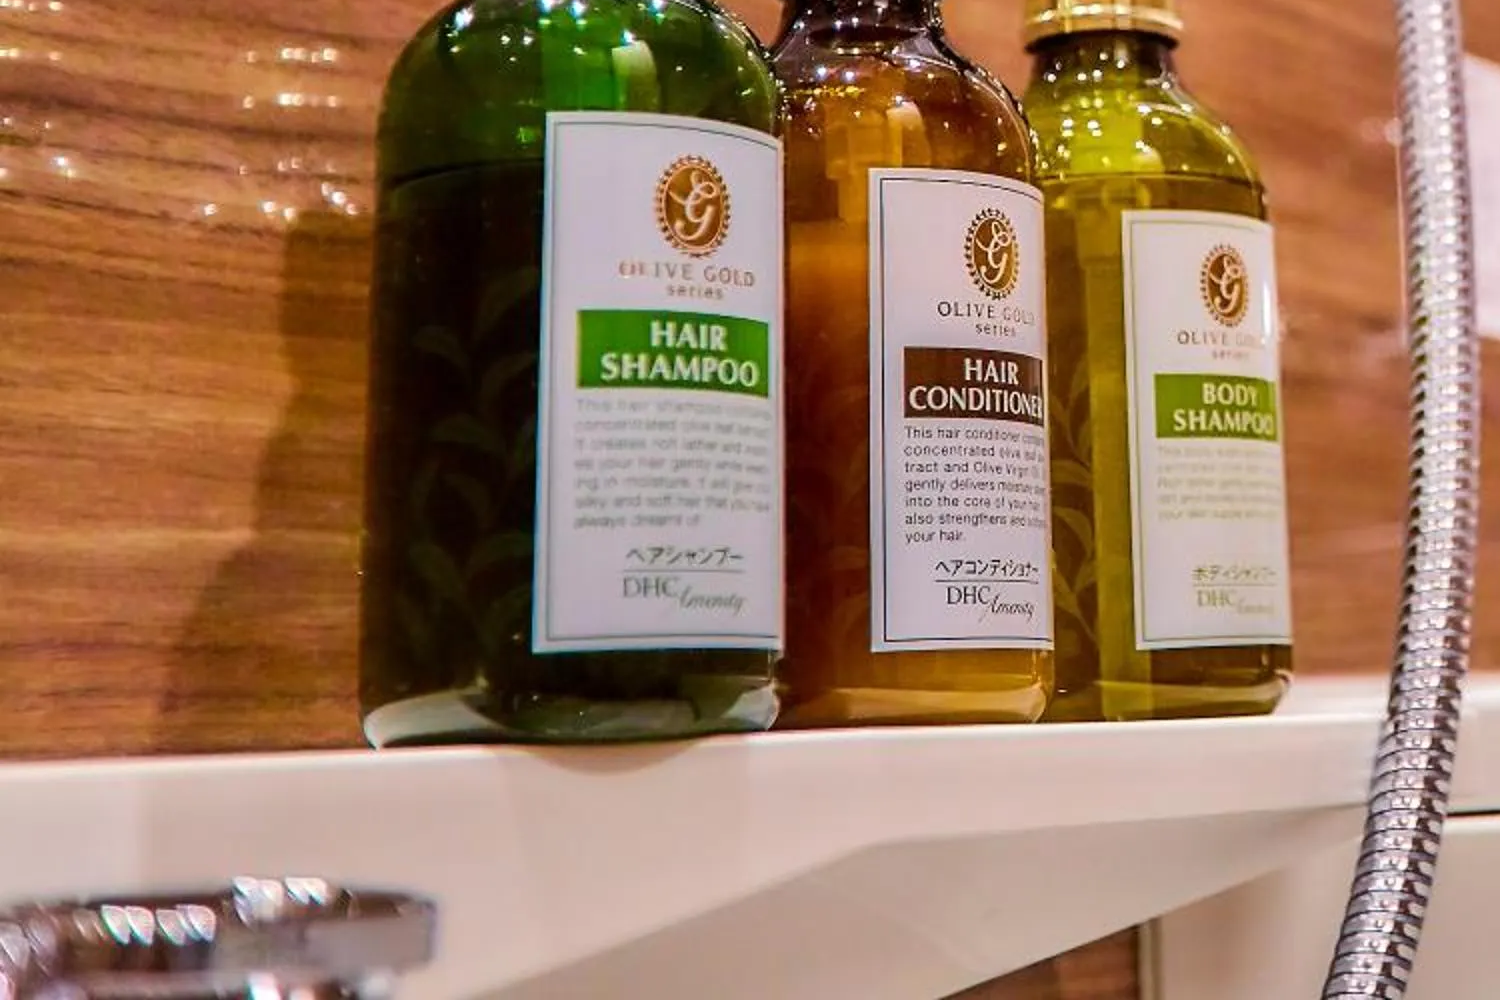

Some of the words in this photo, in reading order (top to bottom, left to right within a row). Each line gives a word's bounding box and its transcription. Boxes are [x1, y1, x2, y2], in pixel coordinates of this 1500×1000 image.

[703, 264, 756, 288] GOLD
[665, 283, 725, 300] series
[937, 301, 995, 319] OLIVE
[651, 320, 728, 351] HAIR
[975, 323, 1016, 337] series
[600, 353, 760, 388] SHAMPOO
[965, 357, 1019, 385] HAIR
[1202, 382, 1257, 407] BODY
[1173, 408, 1274, 436] SHAMPOO
[904, 425, 933, 439] This
[904, 445, 995, 457] concentrated
[905, 462, 938, 473] tract
[943, 462, 969, 473] and
[905, 478, 946, 493] gently
[950, 477, 995, 491] delivers
[905, 496, 933, 507] into
[937, 495, 960, 507] the
[964, 497, 991, 509] core
[905, 513, 934, 525] also
[905, 531, 936, 546] your
[623, 577, 680, 598] DHC
[947, 586, 991, 605] DHC
